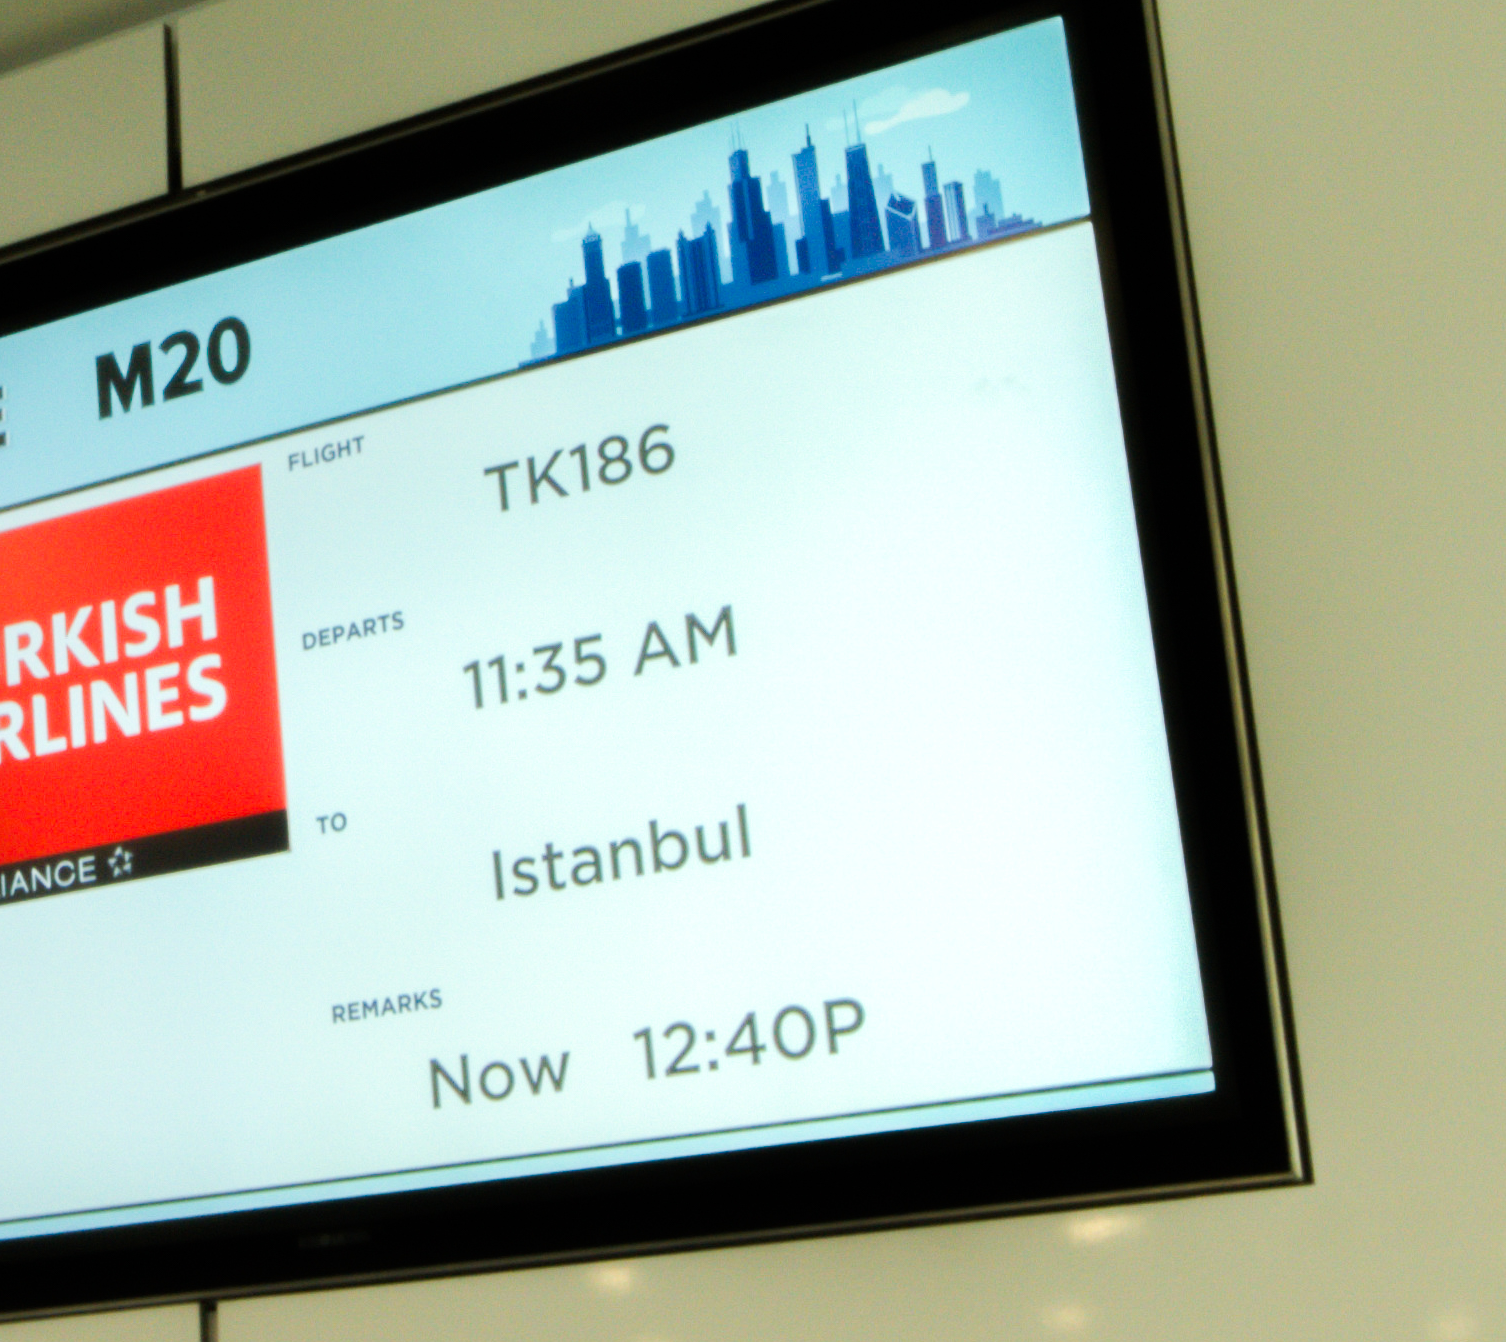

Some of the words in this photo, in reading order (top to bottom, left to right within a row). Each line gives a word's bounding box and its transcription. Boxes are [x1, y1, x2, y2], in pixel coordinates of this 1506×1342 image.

[96, 317, 250, 418] M20
[289, 436, 363, 470] FLIGHT
[484, 424, 675, 511] TK186
[302, 611, 404, 650] DEPARTS
[463, 634, 606, 708] 11:35
[634, 605, 736, 675] AM
[316, 812, 347, 834] TO
[493, 804, 750, 900] Istanbul
[332, 988, 442, 1023] REMARKS
[430, 1052, 569, 1108] Now
[634, 998, 864, 1079] 12:40P
